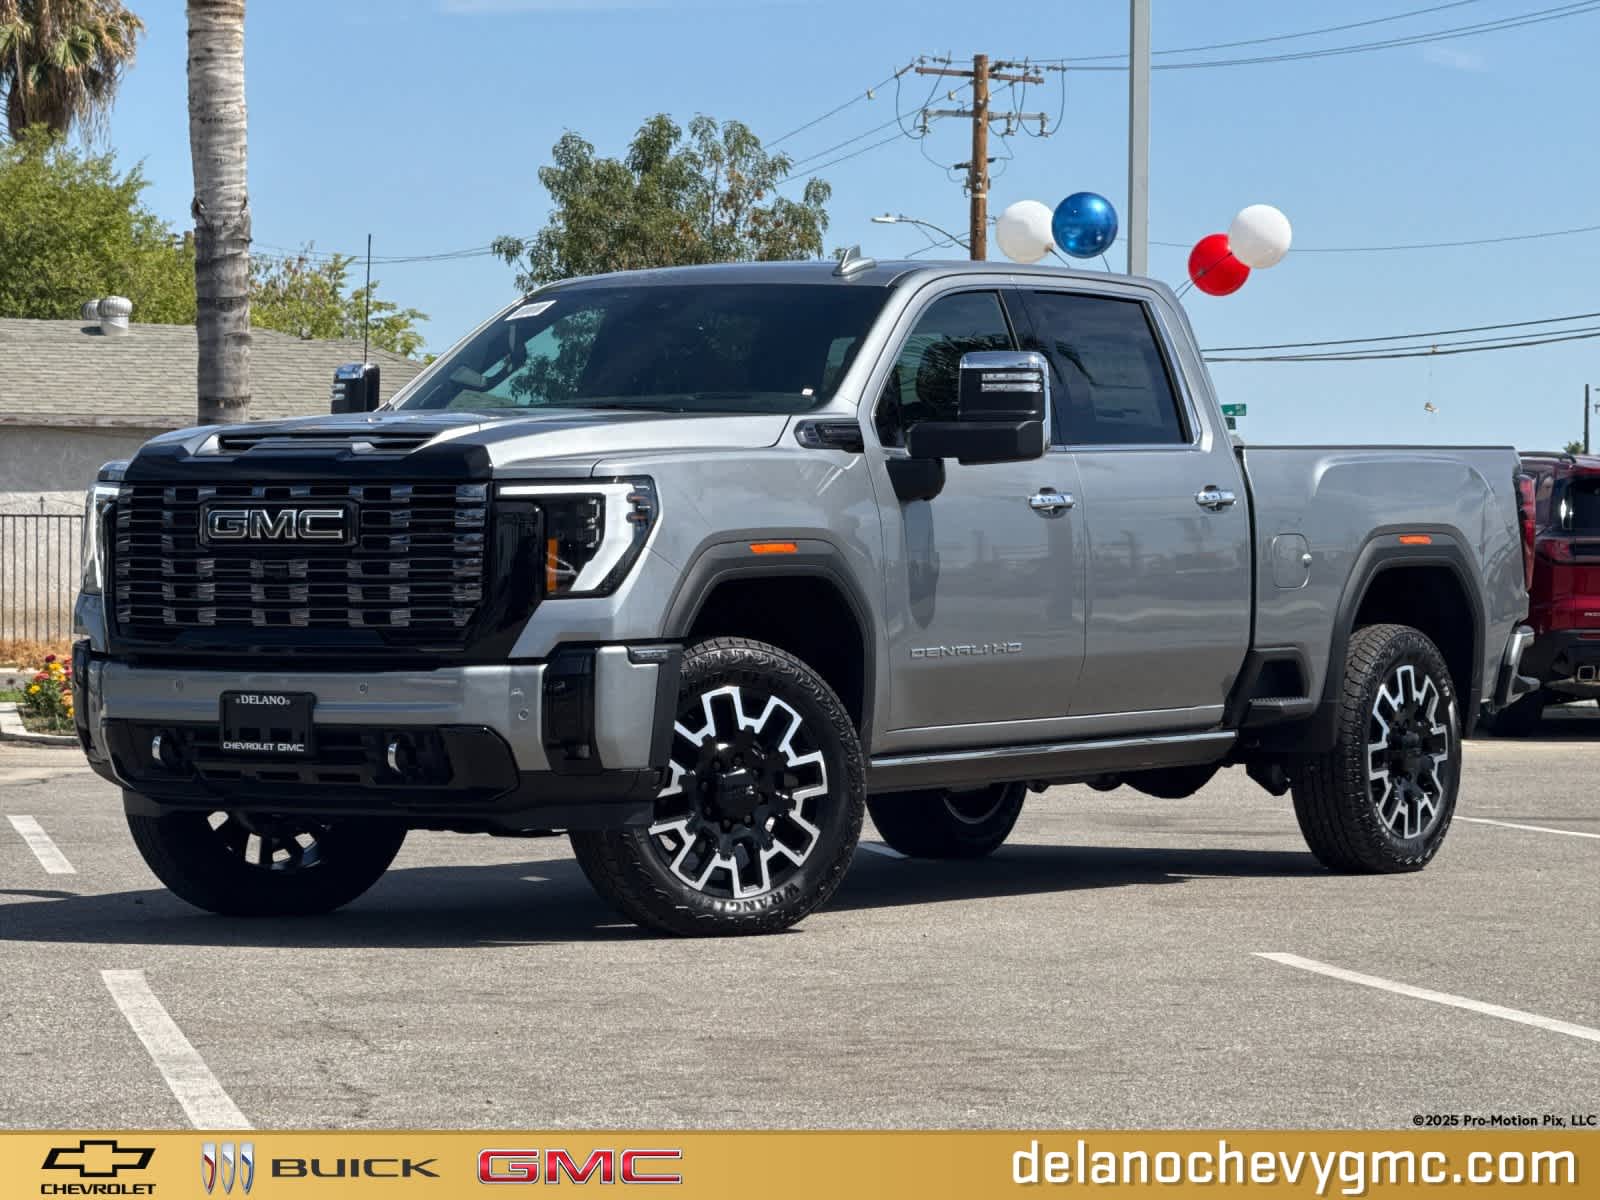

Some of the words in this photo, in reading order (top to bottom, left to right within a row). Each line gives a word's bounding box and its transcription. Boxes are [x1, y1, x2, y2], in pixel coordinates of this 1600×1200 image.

[207, 509, 344, 539] GMC
[911, 643, 991, 657] DENALI
[240, 694, 286, 706] DELANO
[223, 741, 274, 751] CHEVROLET
[277, 743, 305, 752] GMC
